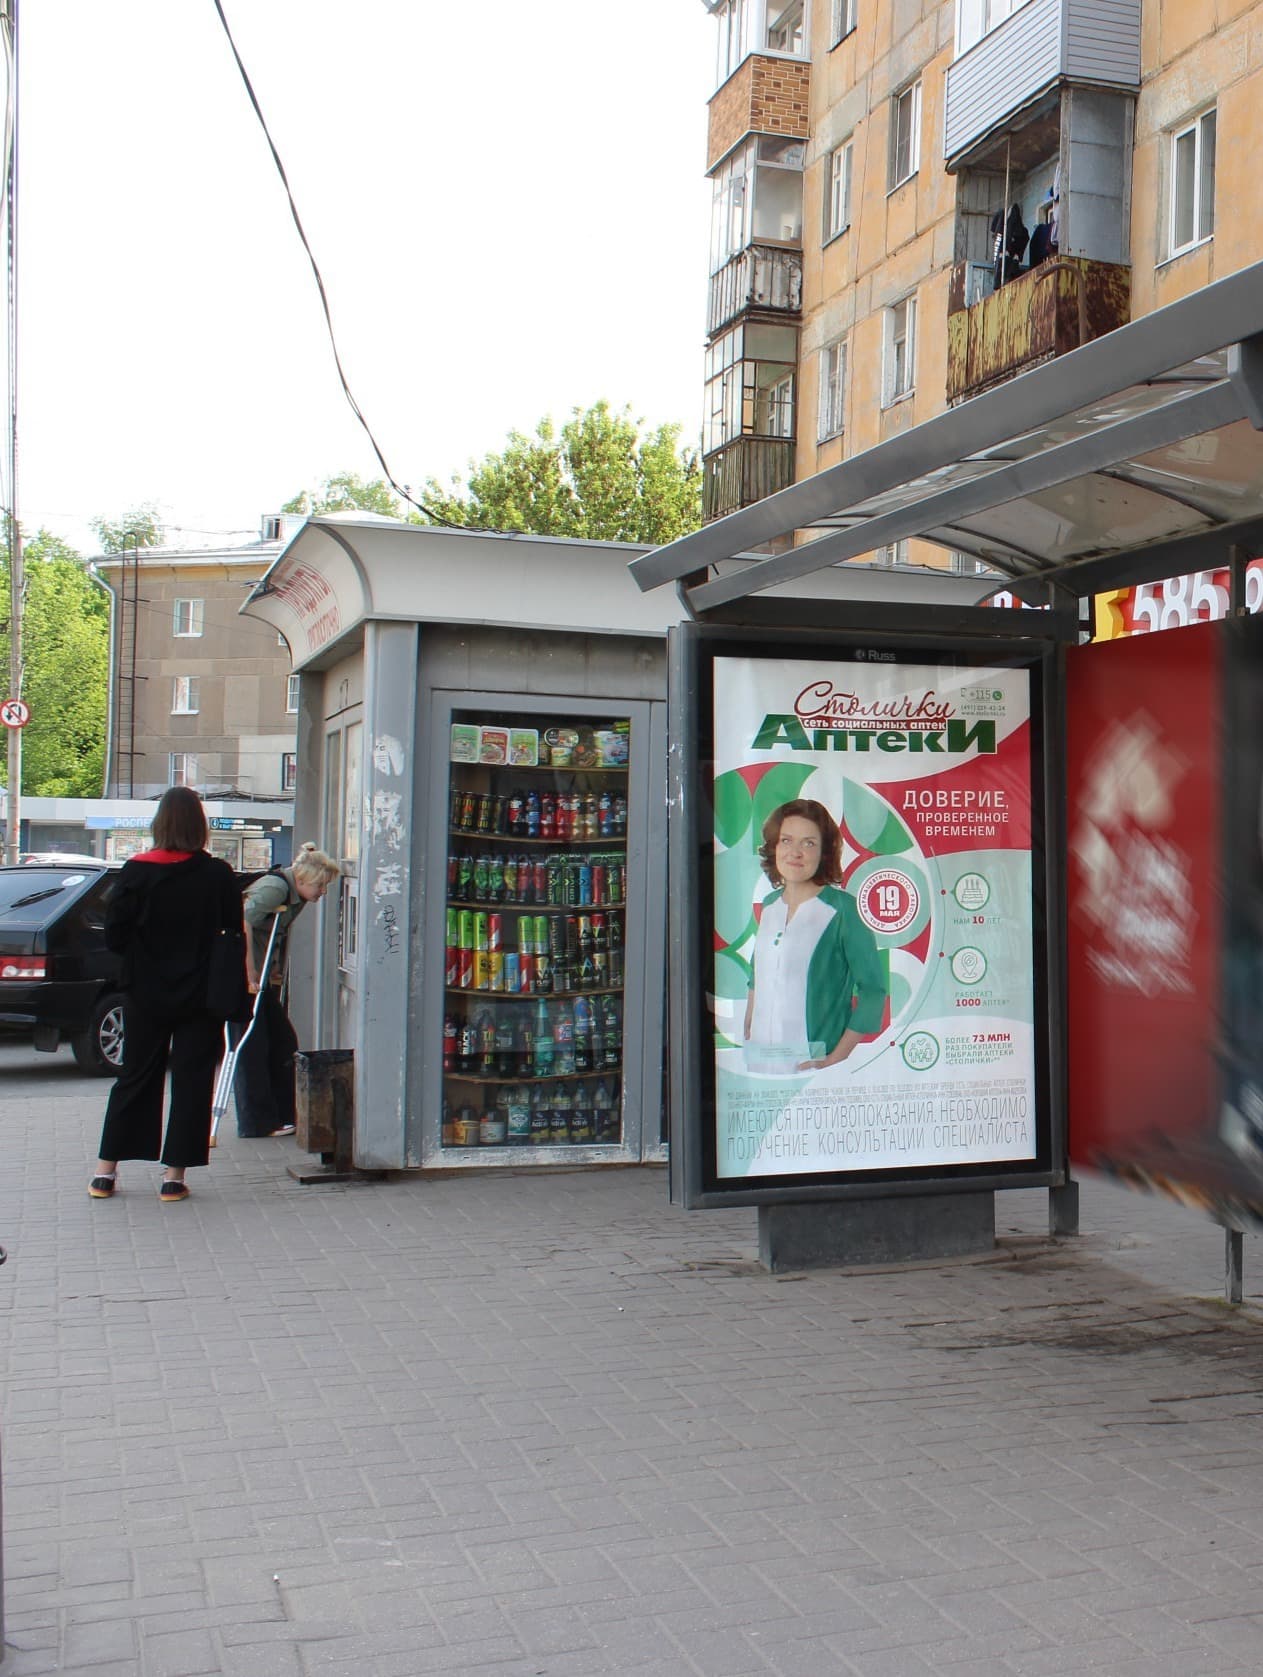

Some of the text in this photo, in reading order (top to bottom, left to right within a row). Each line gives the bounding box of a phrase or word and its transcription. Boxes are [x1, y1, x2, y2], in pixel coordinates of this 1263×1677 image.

[868, 650, 896, 661] Russ
[794, 681, 956, 718] Столички
[804, 719, 946, 731] сеть социальных аптек
[903, 790, 1009, 810] ДОВЕРИЕ,
[114, 817, 152, 828] РОСПЕ
[917, 812, 1009, 823] ПРОВЕРЕННОЕ
[926, 825, 996, 837] ВРЕМЕНЕМ
[876, 885, 900, 910] 19
[972, 916, 984, 924] 10
[955, 999, 981, 1007] 1000
[987, 1033, 1011, 1042] МЛН
[727, 1096, 1027, 1133] ИМЕЮТСЯ ПРОТИВОПОКАЗАНИЯ. НЕОБХОДИМО
[727, 1121, 1028, 1160] ПОЛУЧЕНИЕ КОНСУЛЬТАЦИИ СПЕЦИАЛИСТА
